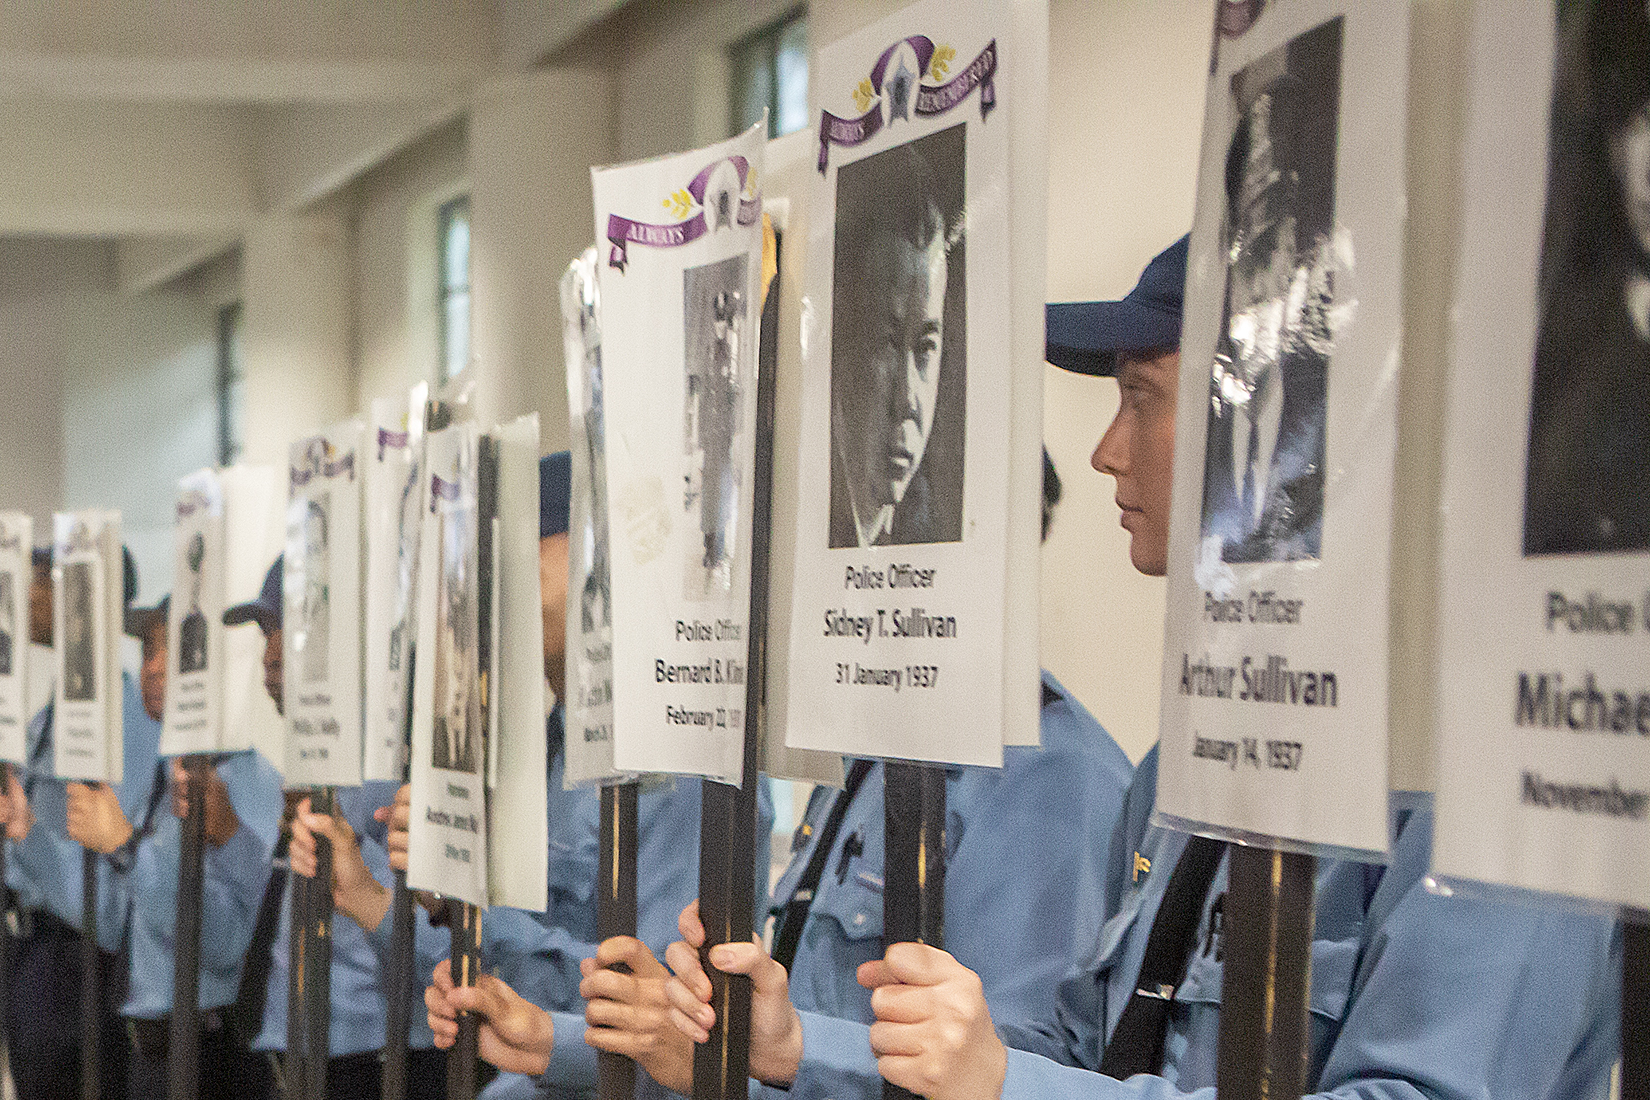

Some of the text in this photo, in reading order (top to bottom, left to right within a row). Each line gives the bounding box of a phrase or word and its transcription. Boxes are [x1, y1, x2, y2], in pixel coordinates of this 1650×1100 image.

[626, 223, 685, 246] ALWAYS
[844, 563, 936, 589] Police Officer
[1204, 591, 1304, 625] Police Officer
[1544, 588, 1636, 634] Police
[676, 619, 712, 642] Police
[824, 607, 957, 645] Sidney T. Sullivan
[654, 657, 713, 684] Bernard
[836, 662, 938, 693] 31 January 1937
[1178, 653, 1339, 708] Arthur Sullivan
[665, 705, 714, 732] February
[1265, 739, 1303, 771] 1937
